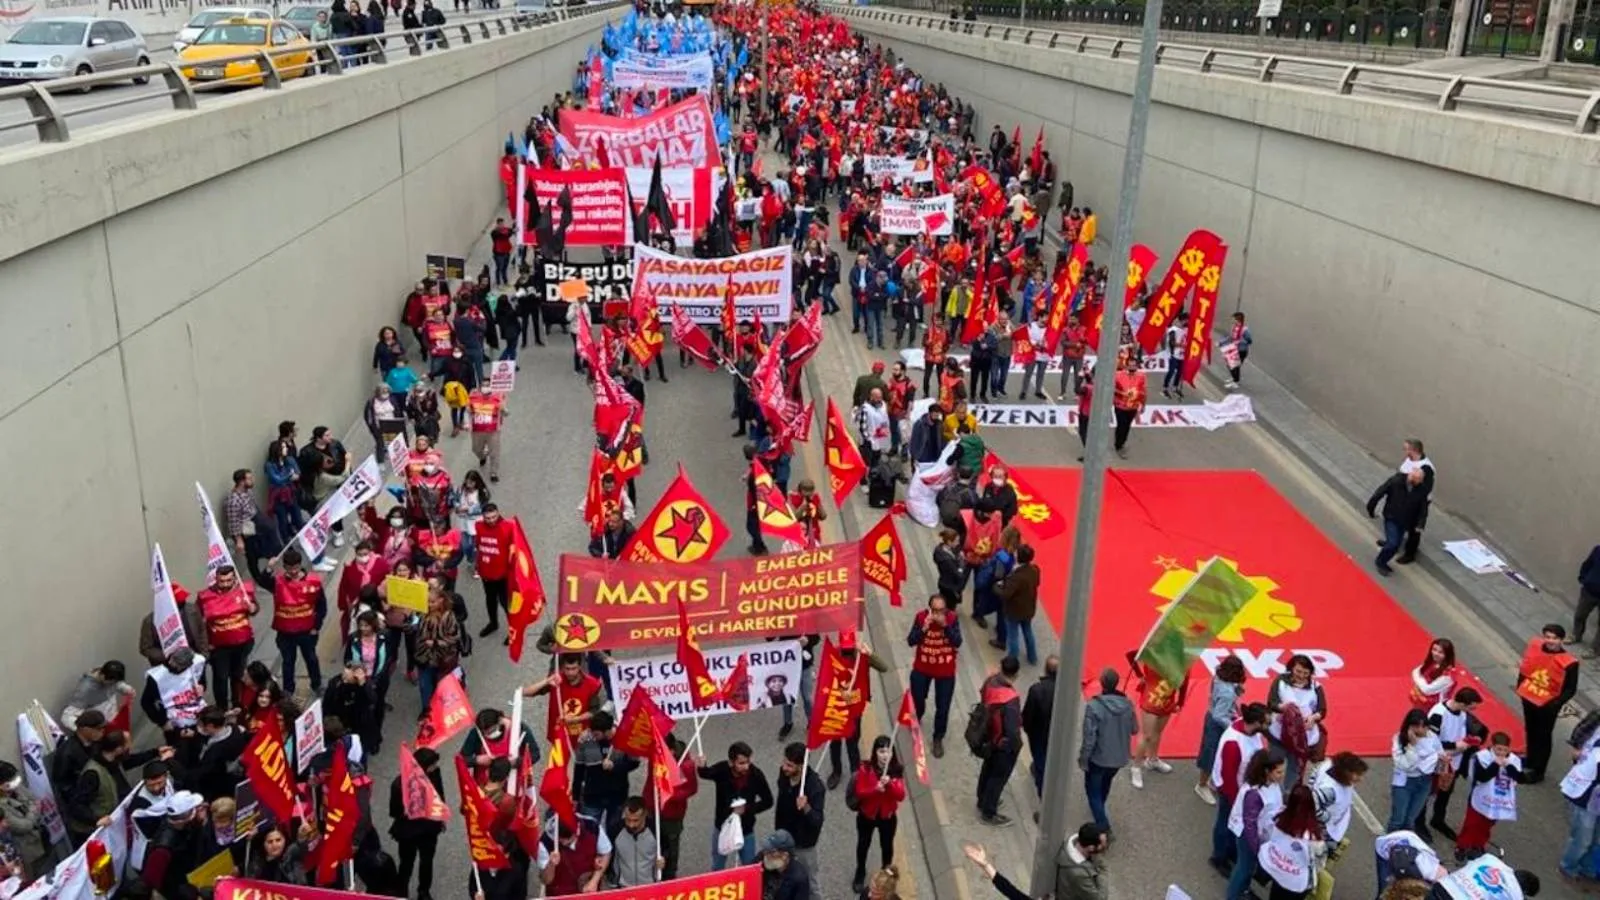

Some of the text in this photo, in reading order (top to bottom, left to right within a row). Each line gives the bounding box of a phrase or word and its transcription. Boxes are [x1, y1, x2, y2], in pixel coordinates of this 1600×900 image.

[574, 109, 705, 153] ZORBALAR
[544, 263, 577, 281] BİZ
[580, 264, 609, 282] BU
[1150, 272, 1187, 328] TKP
[1190, 296, 1211, 361] TKP
[976, 405, 1057, 425] ÜZENİ
[756, 549, 834, 574] EMEĞİN
[566, 576, 709, 605] 1 MAYIS
[738, 567, 849, 595] MÜCADELE
[737, 589, 849, 615] GÜNÜDÜR!
[630, 620, 713, 640] DEVRİCİ
[719, 614, 798, 633] HAREKET
[618, 660, 654, 683] İŞÇİ
[1190, 647, 1345, 679] TKP
